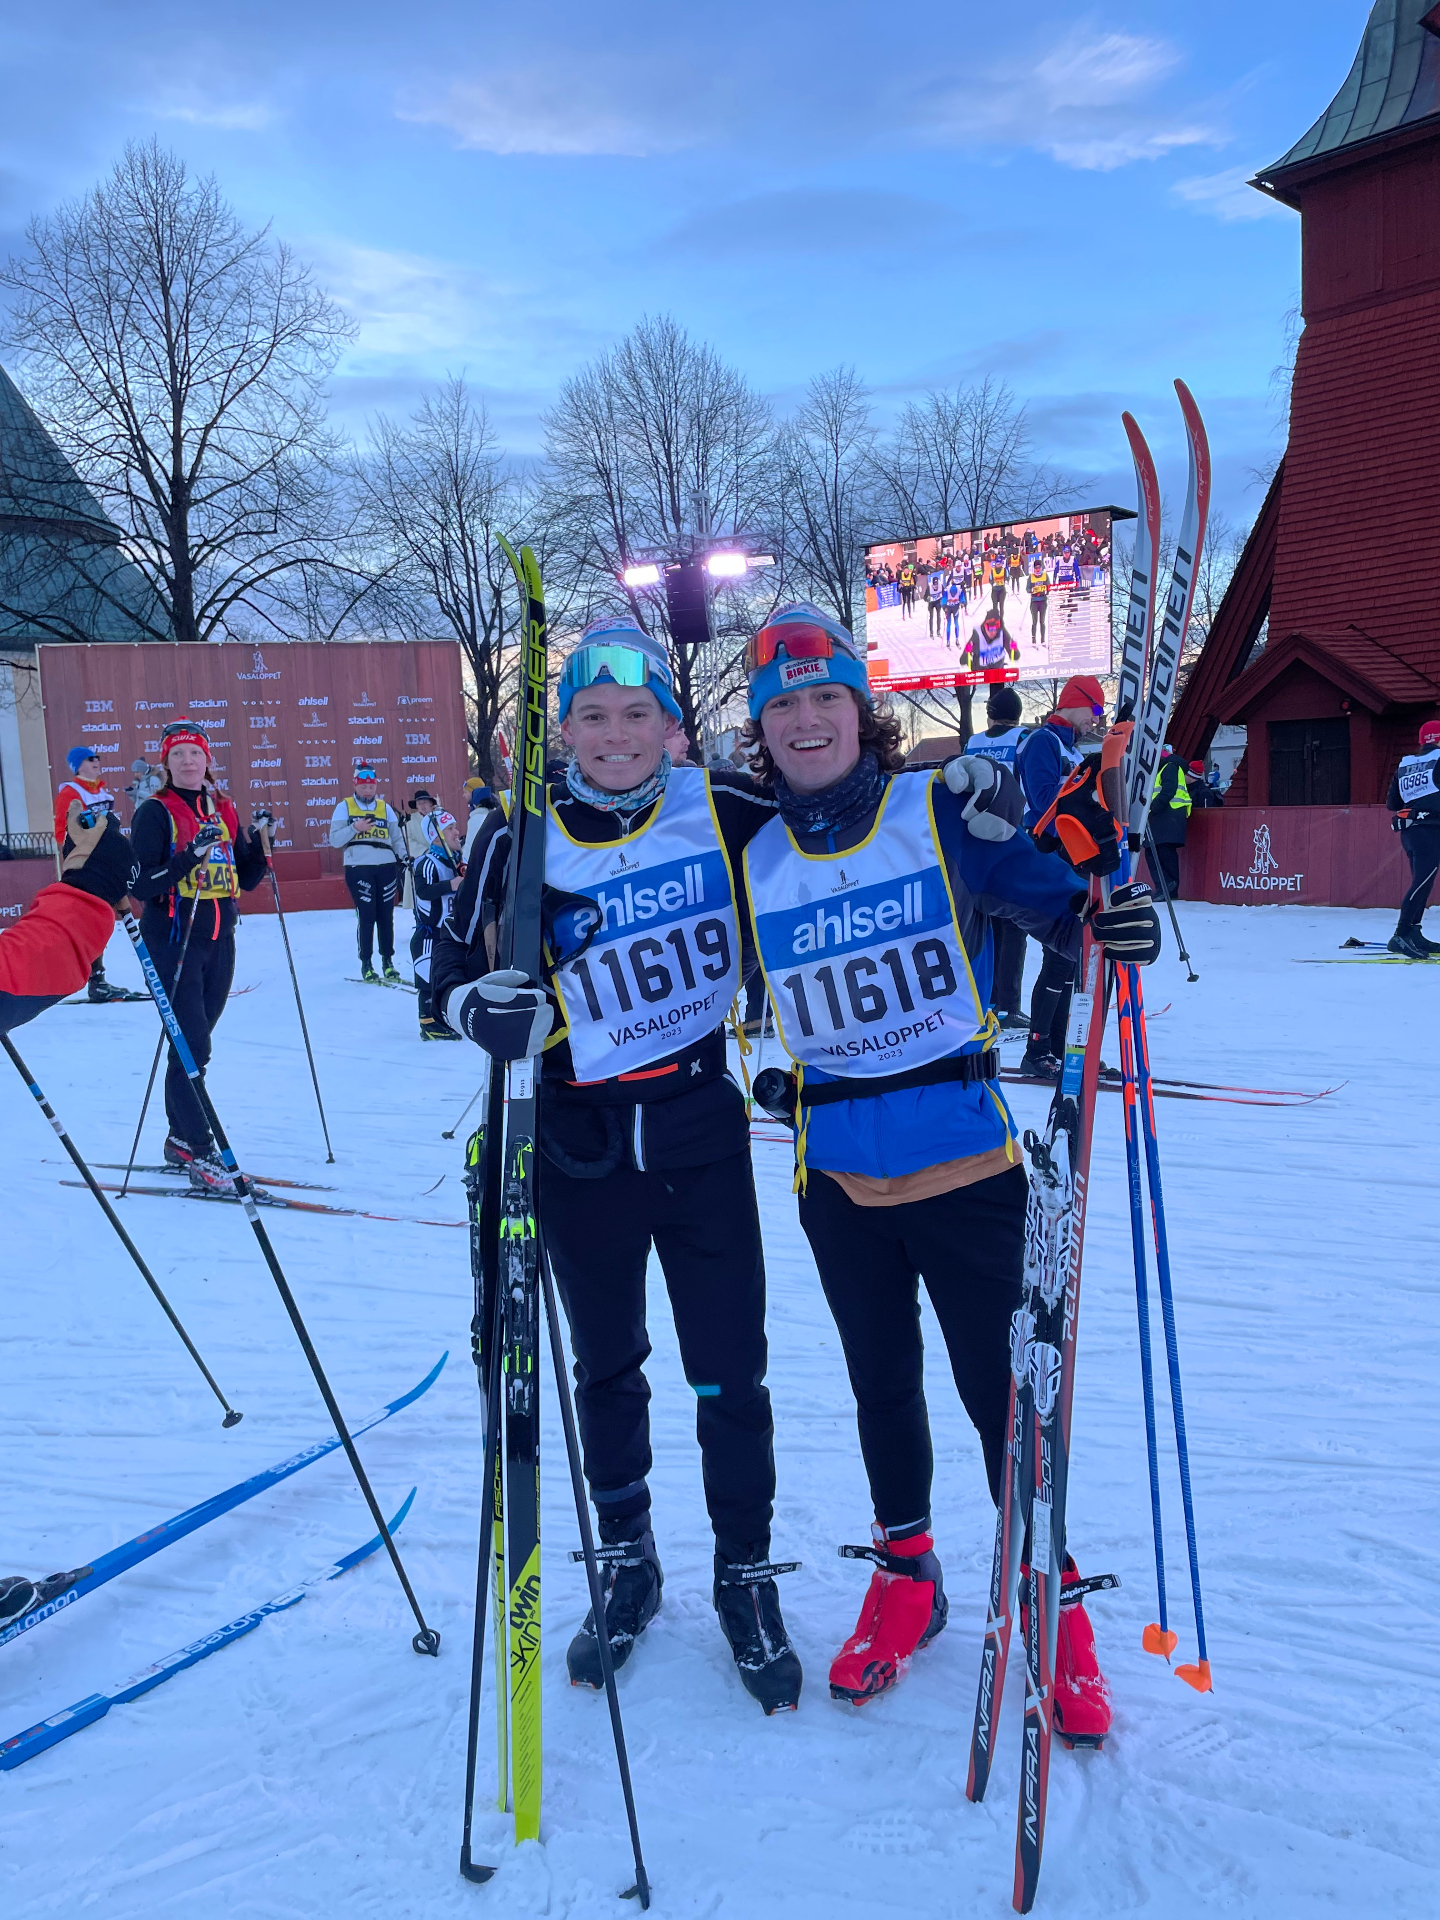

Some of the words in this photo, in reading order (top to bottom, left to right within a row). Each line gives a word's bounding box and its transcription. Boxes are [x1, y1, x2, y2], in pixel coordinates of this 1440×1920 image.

[237, 671, 281, 680] VASALOPPET
[1021, 667, 1057, 677] stadium
[1131, 546, 1191, 806] PELTONEN
[85, 700, 114, 712] IBM
[150, 701, 174, 710] preem
[189, 699, 228, 708] stadium
[298, 696, 329, 706] ahlsell
[249, 716, 277, 728] IBM
[348, 716, 385, 725] stadium
[525, 619, 546, 817] FISCHER
[81, 723, 122, 732] stadium
[353, 735, 383, 745] ahlsell
[405, 733, 431, 745] IBM
[401, 755, 438, 764] stadium
[974, 747, 1009, 760] hlsell
[101, 765, 125, 773] preem
[251, 758, 282, 768] ahlsell
[304, 755, 332, 768] IBM
[1405, 762, 1429, 775] IBM
[301, 777, 339, 786] stadium
[406, 773, 436, 784] ahlsell
[1400, 770, 1429, 792] 10985
[306, 796, 337, 807] ahlsell
[356, 828, 385, 839] 8549
[609, 861, 641, 876] VASALOPPET
[830, 879, 860, 894] VASALOPPET
[1219, 872, 1304, 891] VASALOPPET
[573, 862, 705, 940] ahlsell
[792, 882, 923, 955] ahlsell
[571, 917, 731, 1023] 11619
[783, 937, 958, 1037] 11618
[143, 958, 181, 1037] salomon
[608, 989, 719, 1047] VASALOPPET
[660, 1026, 682, 1041] 2023
[820, 1008, 945, 1057] VASALOPPET
[877, 1048, 903, 1061] 2023
[1062, 1170, 1086, 1342] PELTONEN
[1012, 1396, 1023, 1464] 202
[1040, 1436, 1053, 1509] 202
[863, 1550, 888, 1568] alpina
[992, 1505, 1003, 1606] nanocarbon
[741, 1568, 776, 1579] ROSSIGNOL
[1059, 1583, 1091, 1600] alpina
[985, 1603, 1006, 1659] X
[977, 1649, 995, 1751] INFRA
[1025, 1665, 1049, 1736] X
[1024, 1726, 1040, 1846] INFRA
